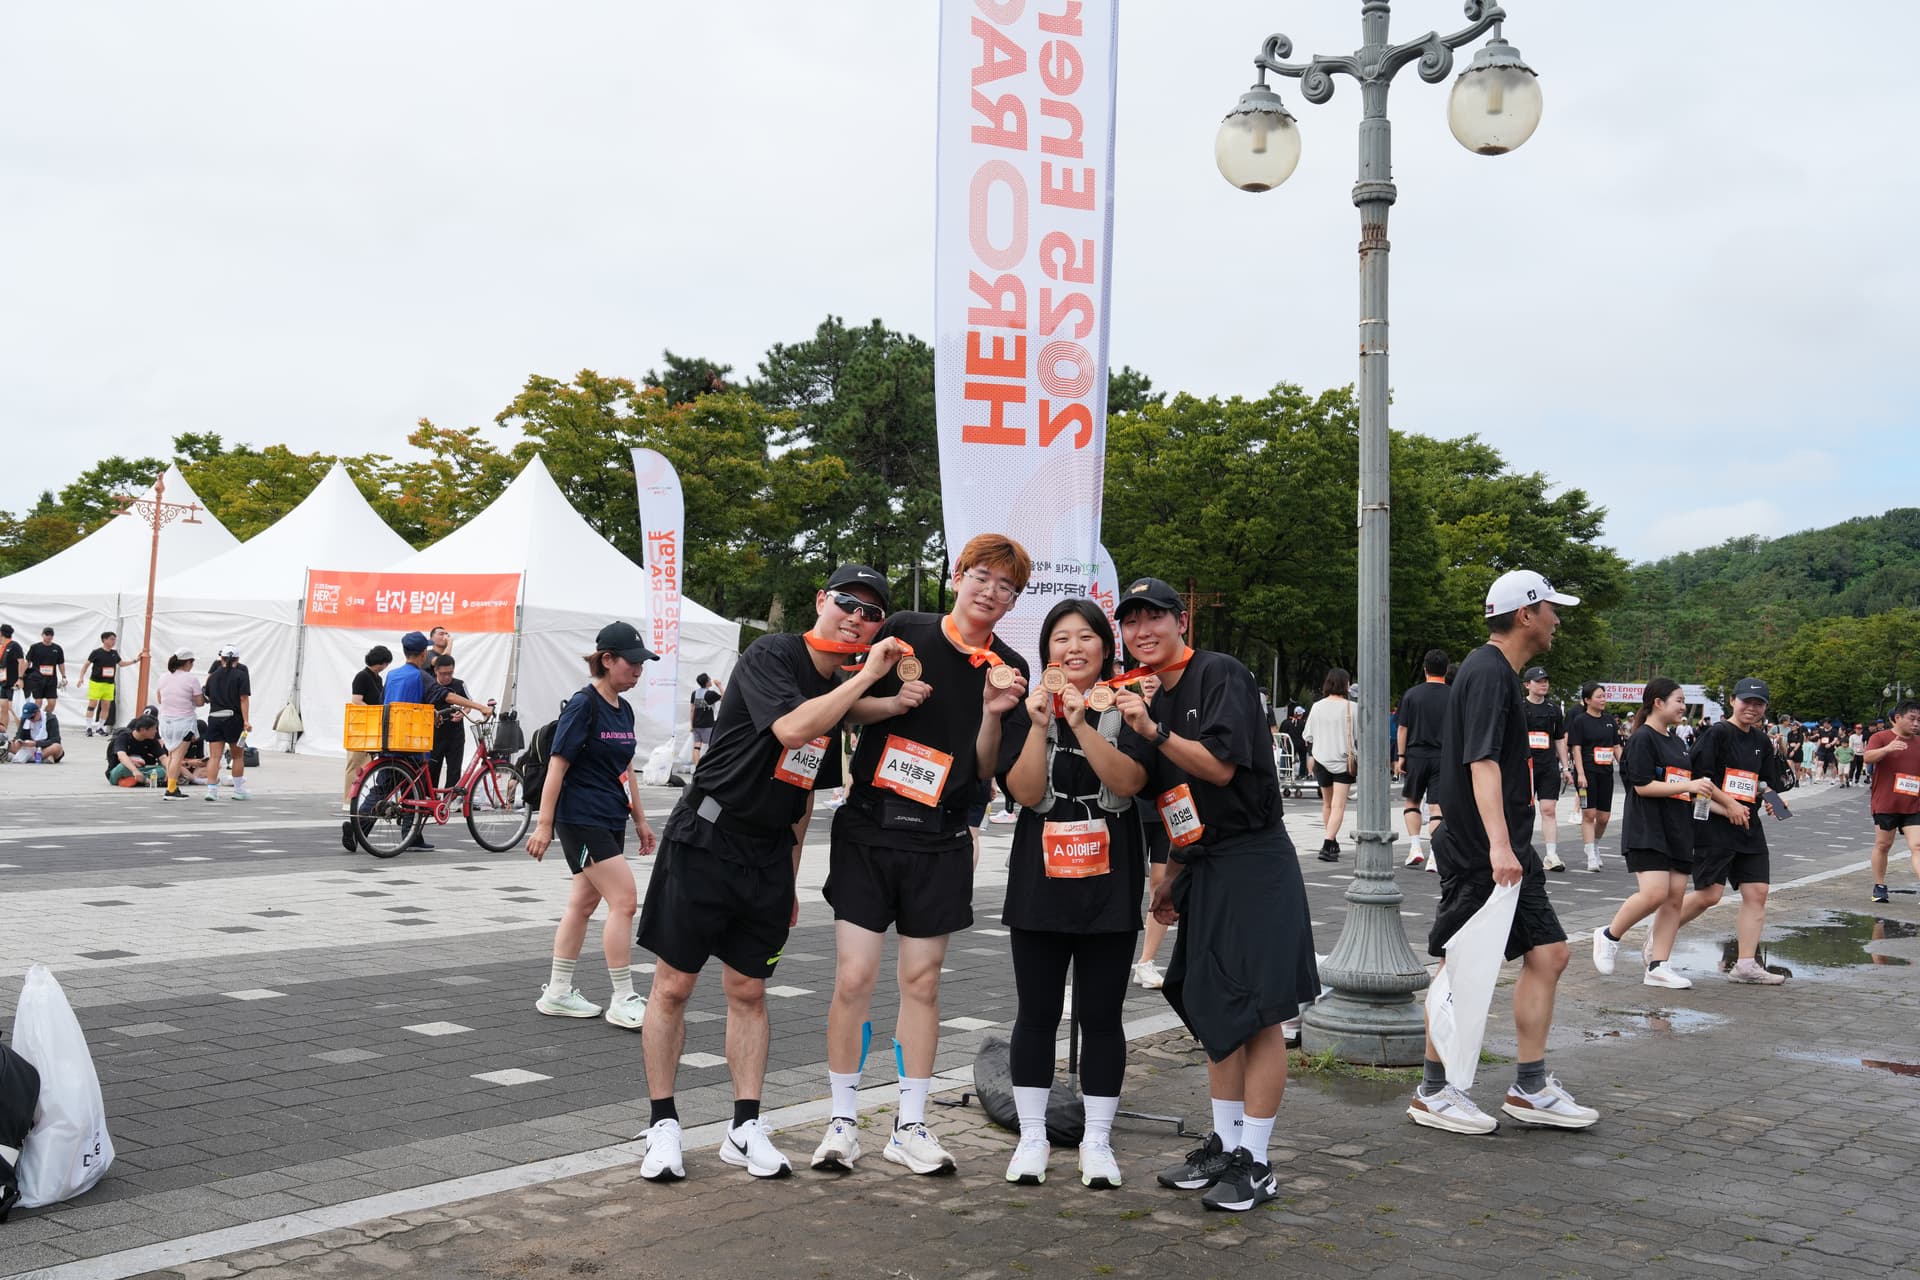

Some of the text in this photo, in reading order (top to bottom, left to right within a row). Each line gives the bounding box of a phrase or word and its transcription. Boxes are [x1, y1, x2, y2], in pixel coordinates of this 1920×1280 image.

[313, 590, 340, 602] HERO
[376, 589, 456, 615] 남자 탈의실
[311, 602, 339, 615] RACE
[792, 751, 801, 764] A
[887, 759, 936, 785] A 박종욱
[1053, 841, 1101, 857] A 이예린
